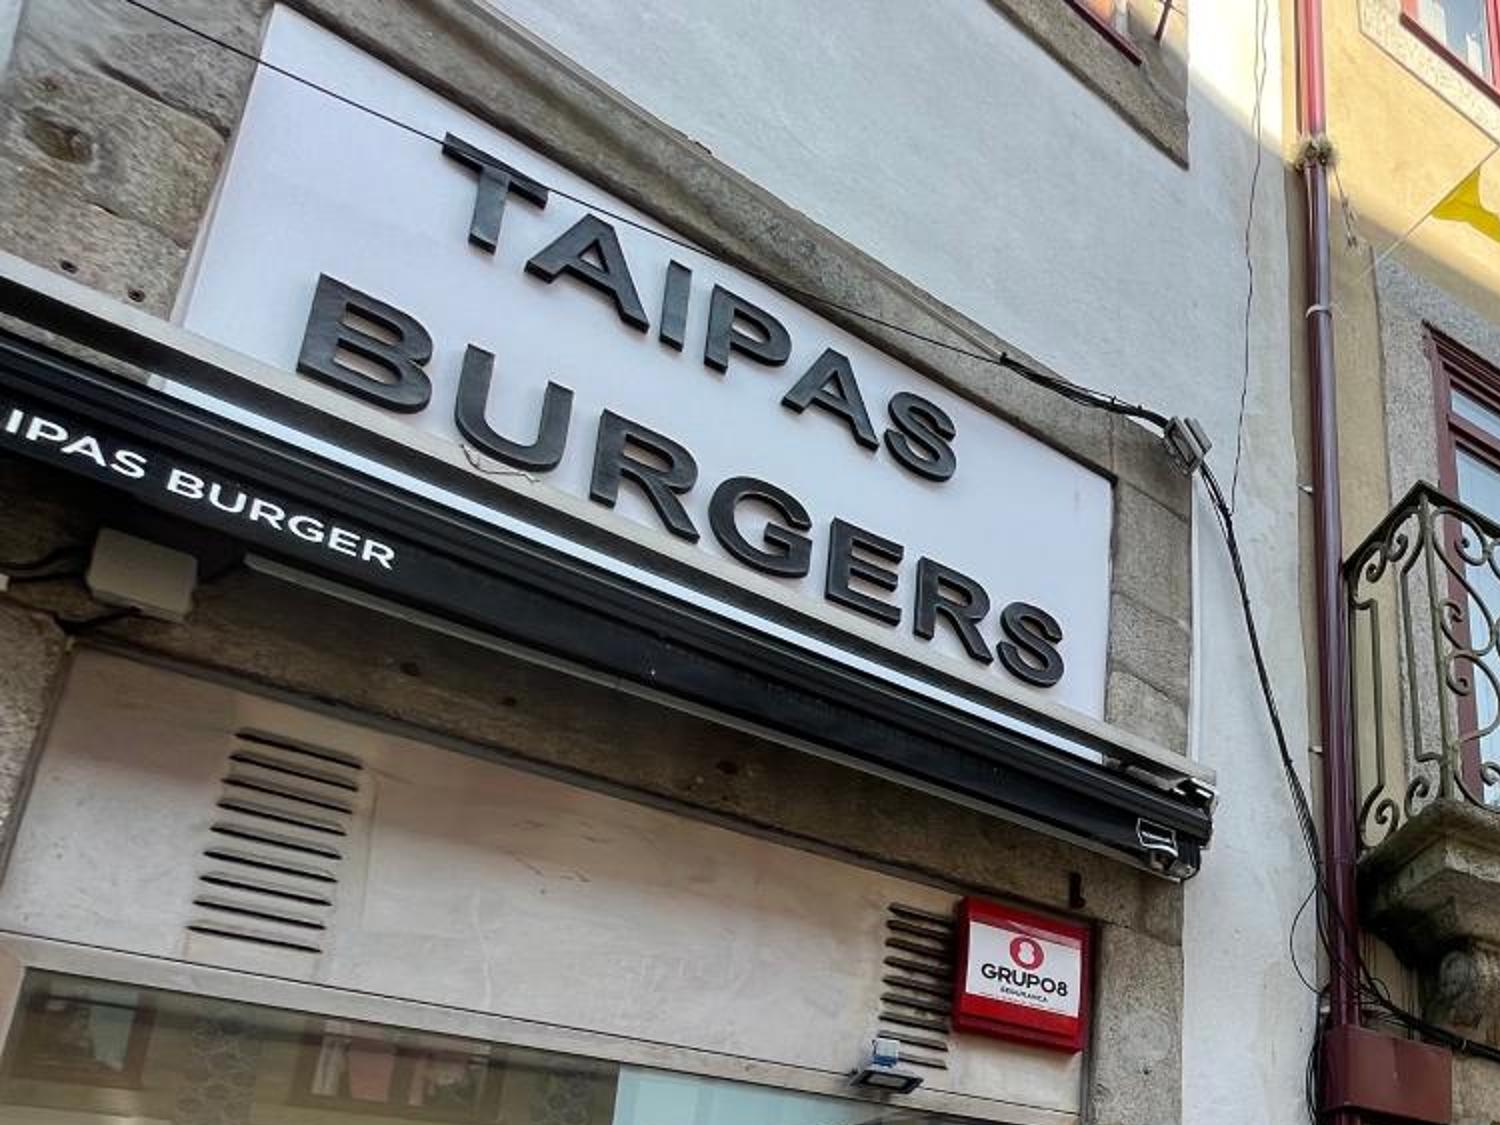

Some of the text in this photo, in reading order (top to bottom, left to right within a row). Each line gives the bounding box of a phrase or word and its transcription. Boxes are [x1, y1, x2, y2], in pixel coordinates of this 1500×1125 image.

[441, 132, 957, 482] TAIPAS
[5, 408, 396, 570] IPAS BURGER
[297, 272, 1065, 687] BURGERS
[981, 963, 1068, 996] GRUPO8
